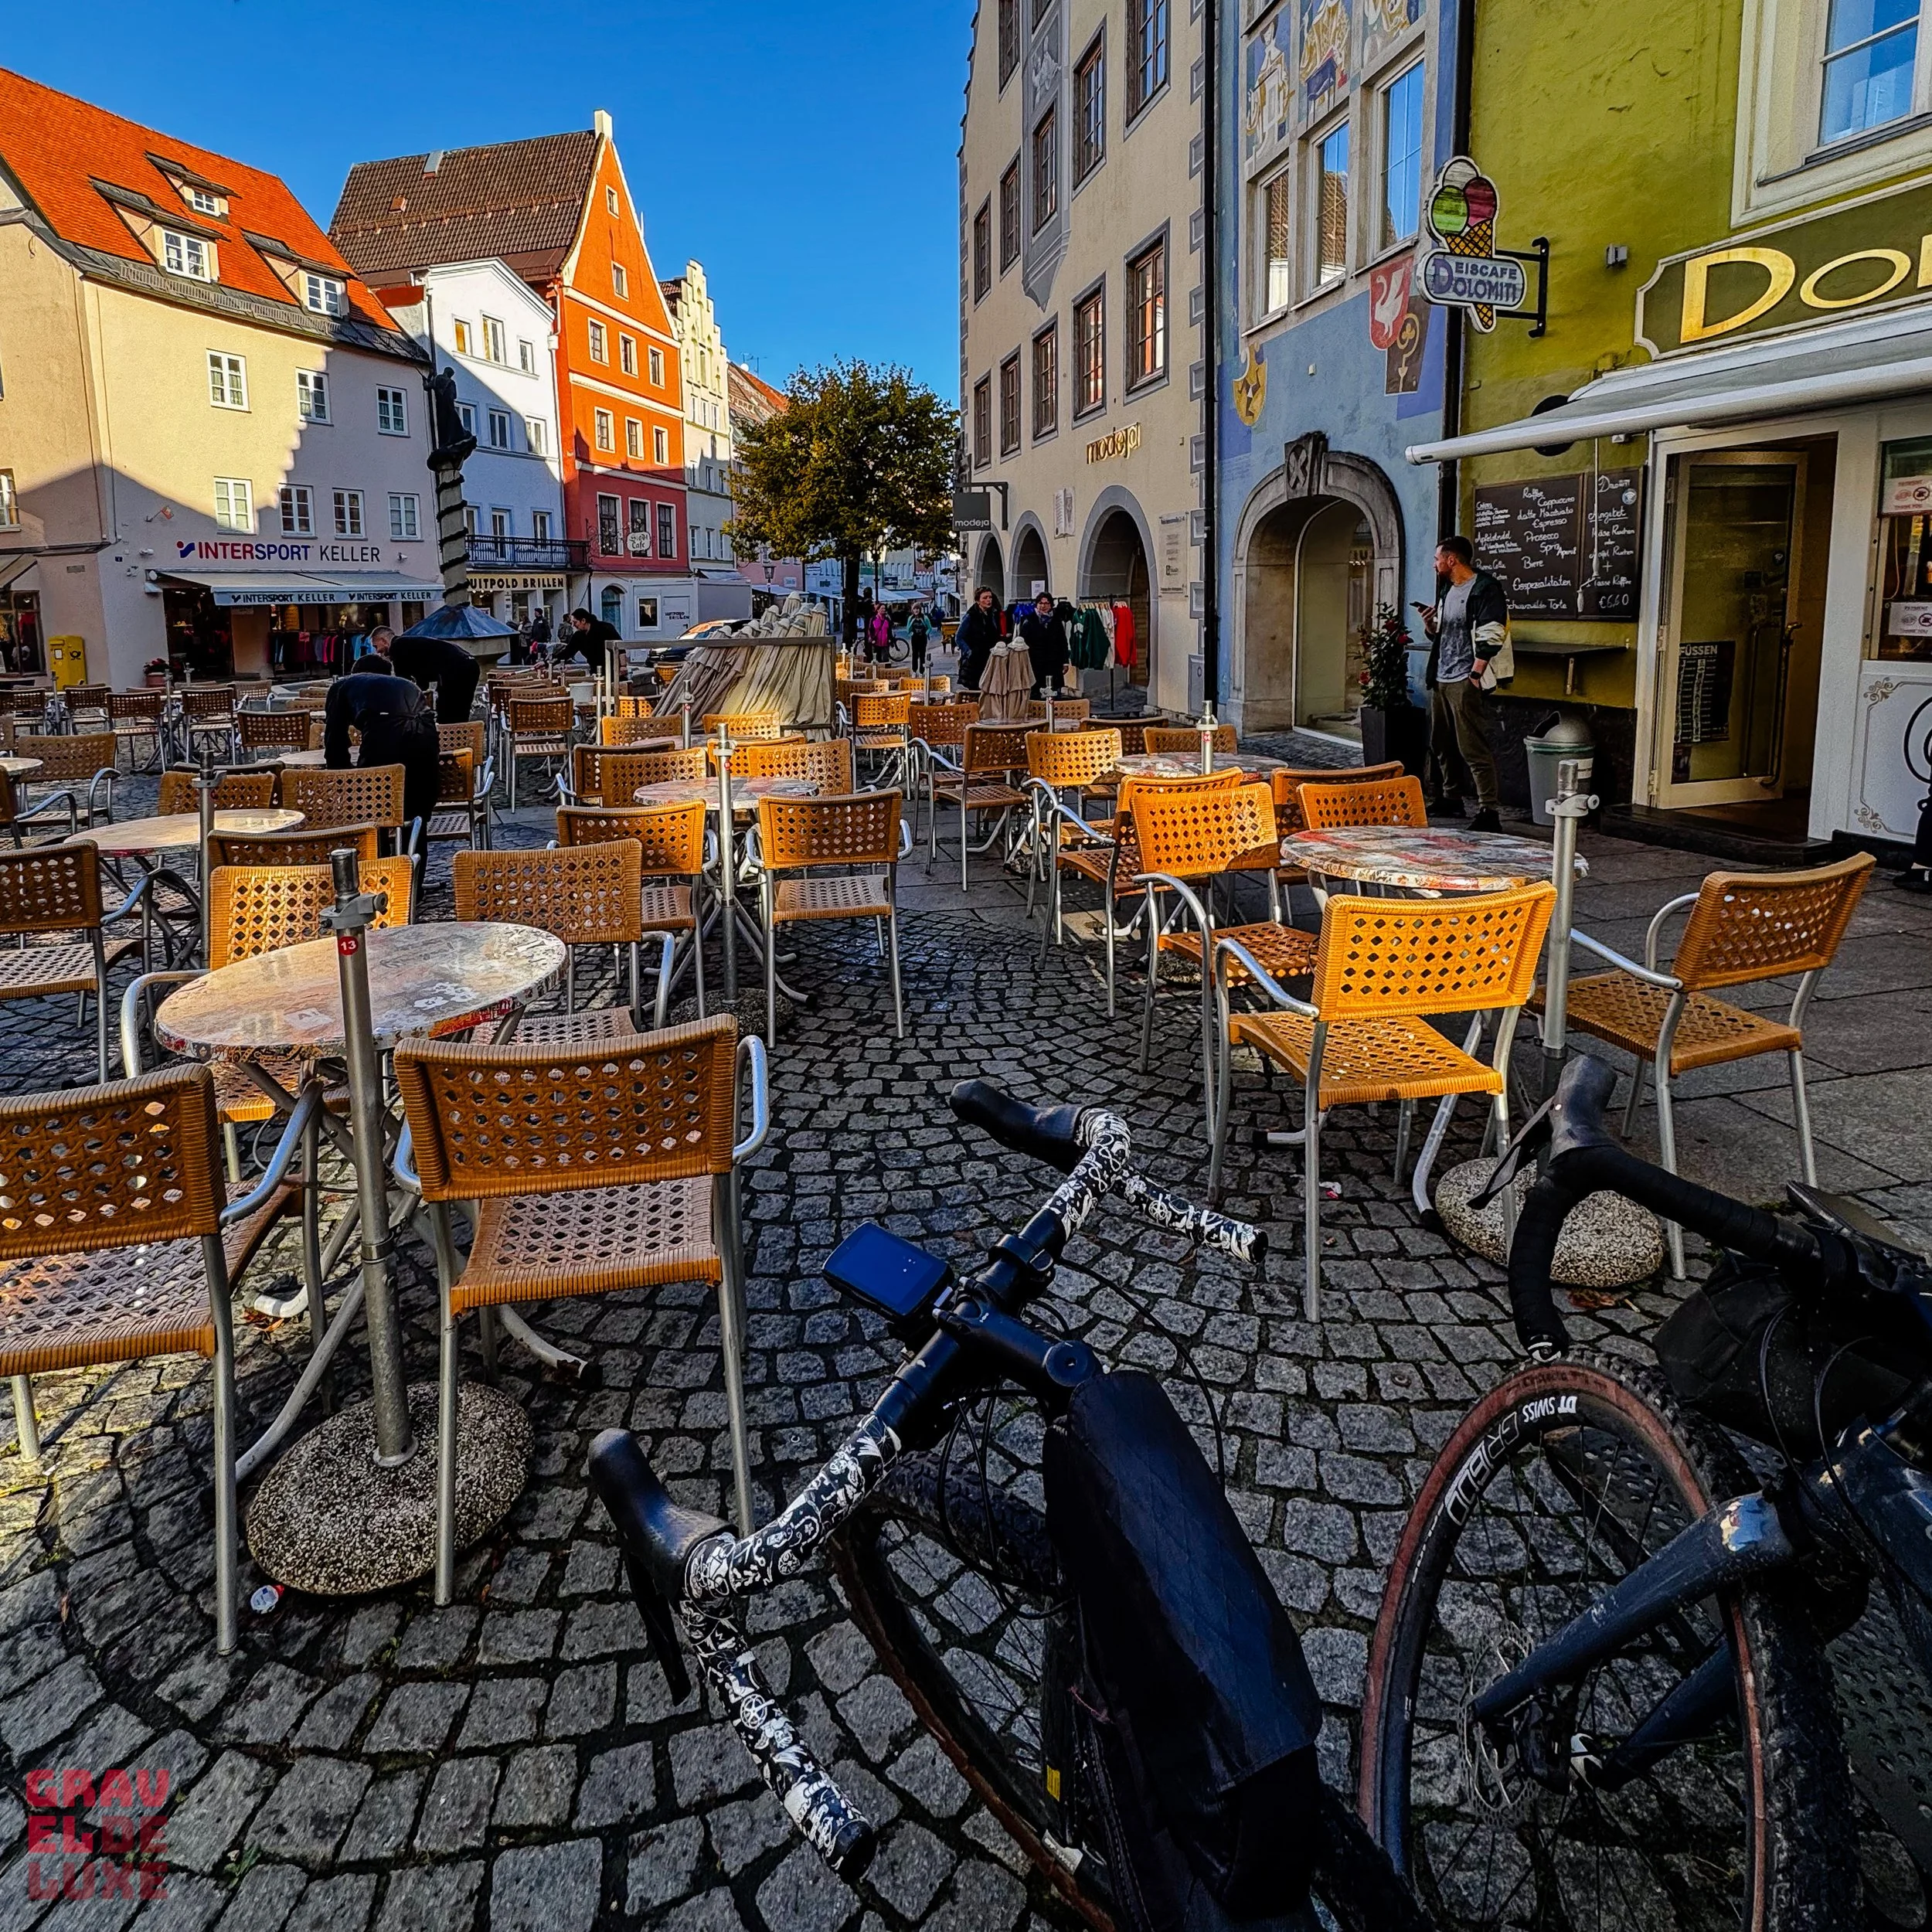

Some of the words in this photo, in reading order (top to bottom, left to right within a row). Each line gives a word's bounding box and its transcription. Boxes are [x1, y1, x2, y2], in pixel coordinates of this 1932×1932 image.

[1454, 261, 1517, 280] EISCAFE
[1433, 257, 1519, 302] DOLOMITI
[1087, 422, 1141, 464] modeja
[955, 519, 989, 527] modeja
[1532, 519, 1567, 532] Espresso
[1523, 530, 1560, 543] Prosecco
[198, 541, 311, 561] INTERSPORT
[320, 545, 381, 563] KELLER
[469, 578, 518, 589] UITPOLD
[522, 577, 564, 588] BRILLEN
[242, 594, 294, 604] INTERSPORT
[298, 593, 336, 603] KELLER
[356, 592, 397, 601] INTERSPORT
[400, 591, 432, 600] KELLER
[341, 940, 356, 951] 13
[1522, 1396, 1556, 1423] SWISS
